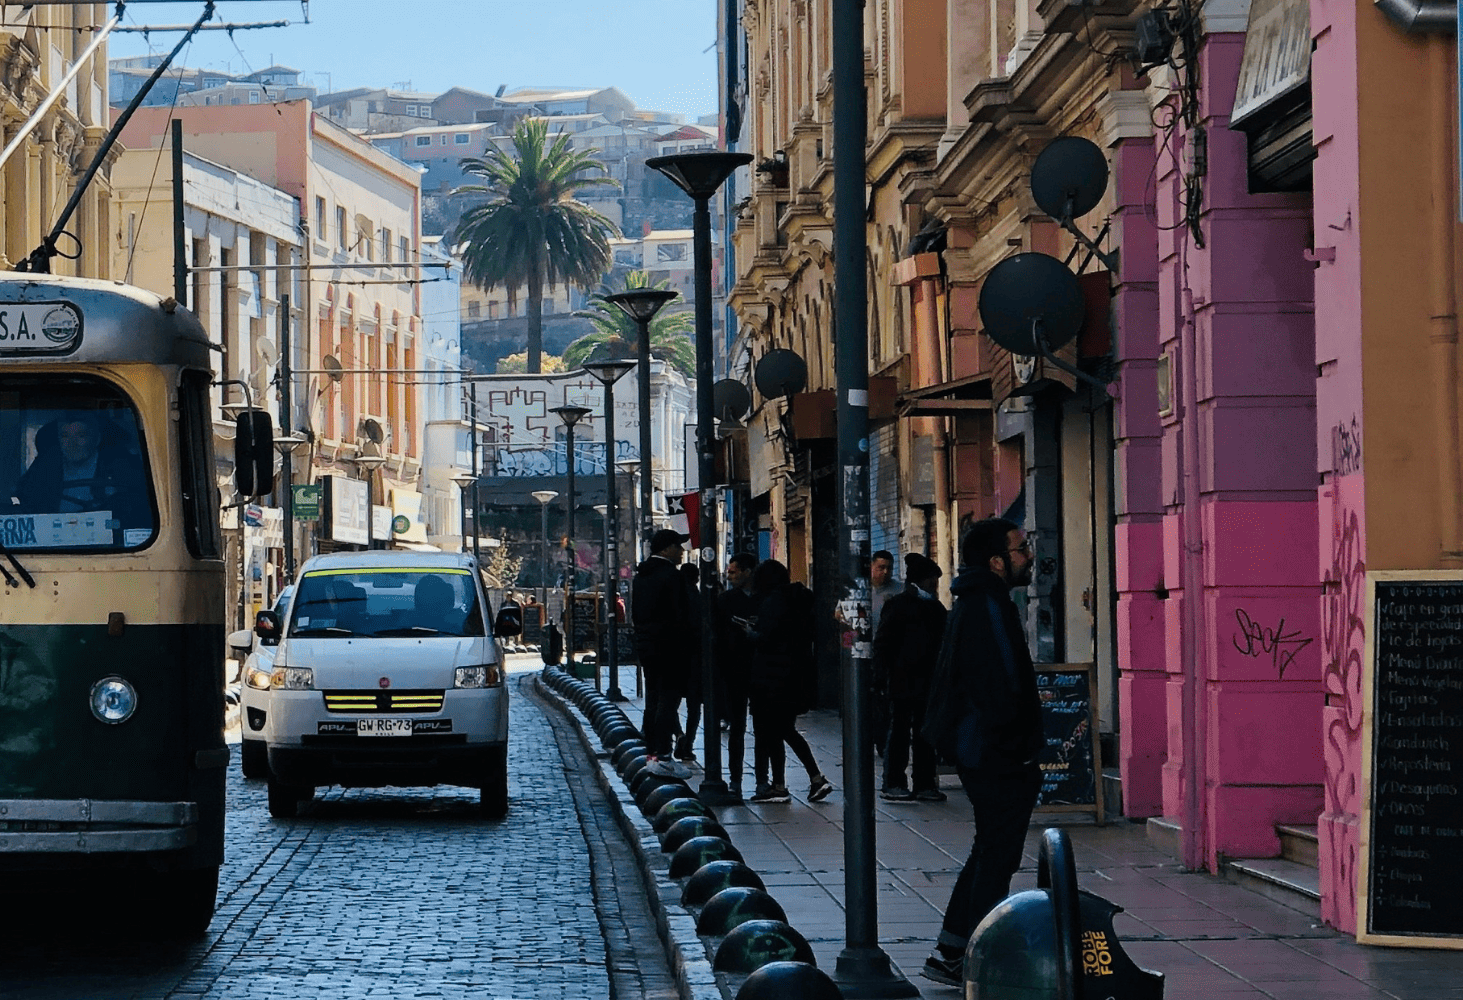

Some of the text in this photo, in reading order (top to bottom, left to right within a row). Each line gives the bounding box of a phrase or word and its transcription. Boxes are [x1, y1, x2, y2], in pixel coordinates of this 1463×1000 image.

[0, 310, 36, 342] S.A.
[414, 722, 440, 730] APV
[1092, 931, 1113, 976] FORE
